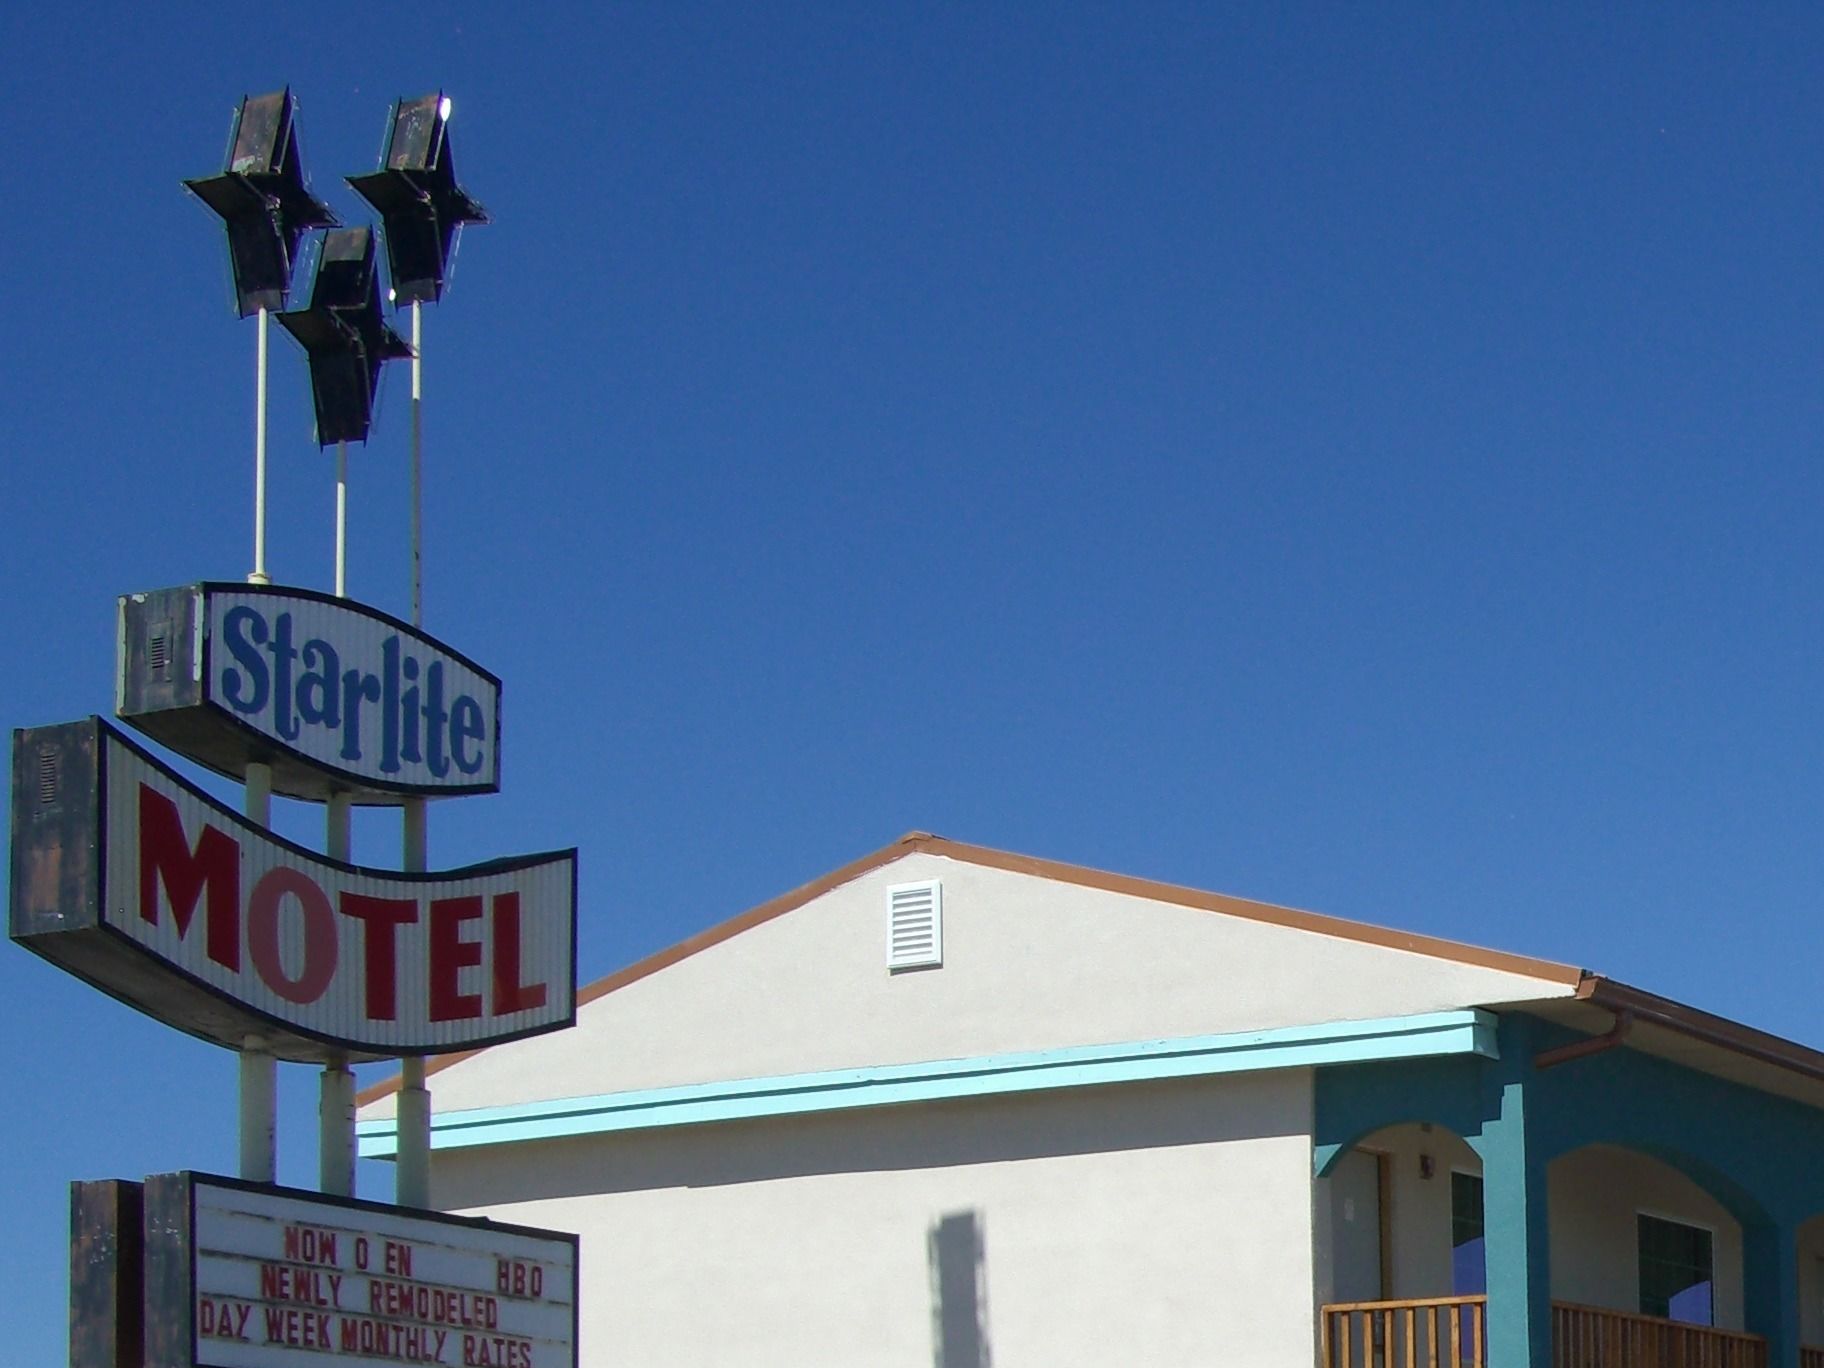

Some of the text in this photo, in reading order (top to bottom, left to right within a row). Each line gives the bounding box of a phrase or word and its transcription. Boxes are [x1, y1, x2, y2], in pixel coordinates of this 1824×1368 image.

[222, 605, 485, 778] Starlite
[138, 781, 547, 1023] MOTEL
[261, 1264, 497, 1329] NEWLY REMODELED
[285, 1226, 337, 1265] NOW
[497, 1259, 542, 1297] HBO
[201, 1300, 250, 1338] DAY
[265, 1308, 331, 1349] WEEK
[341, 1317, 447, 1363] MONTHLY
